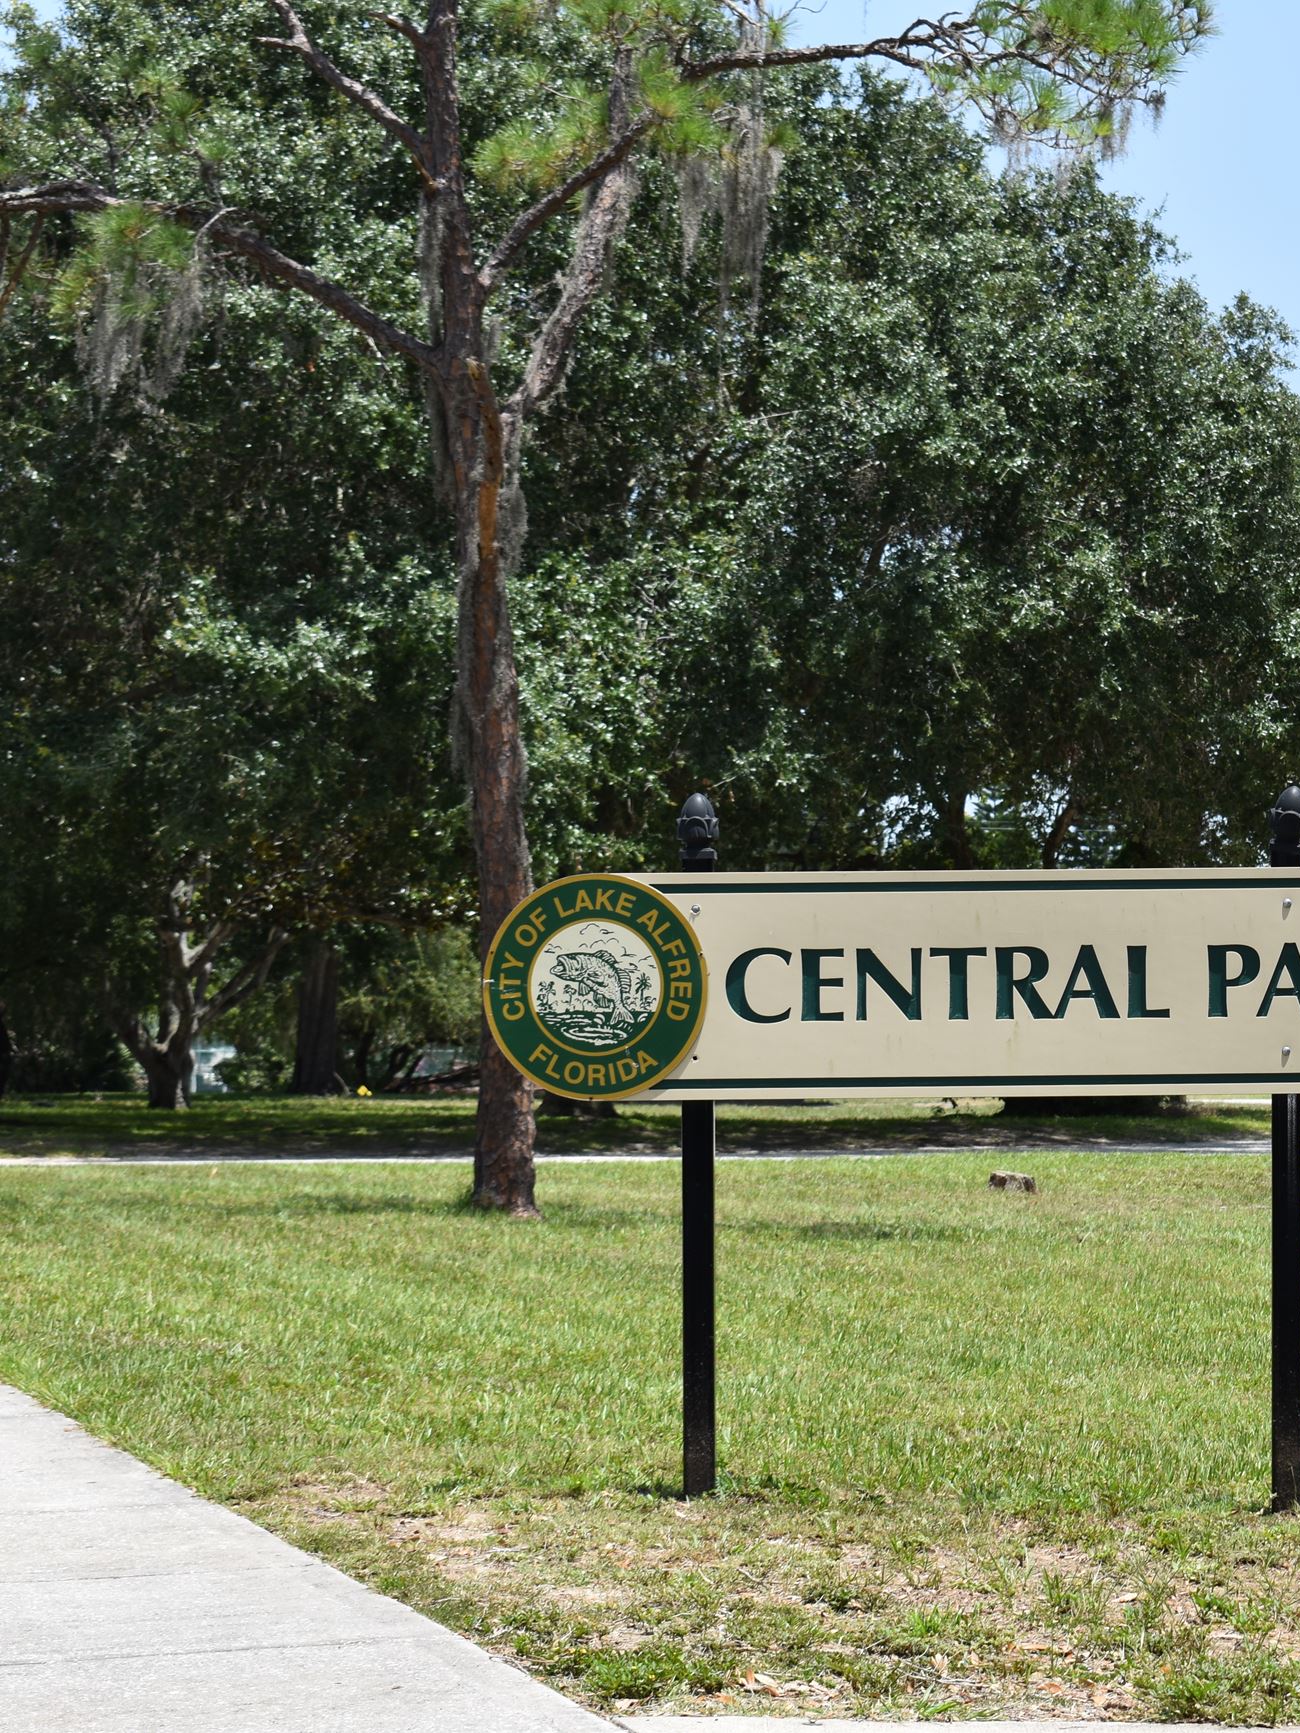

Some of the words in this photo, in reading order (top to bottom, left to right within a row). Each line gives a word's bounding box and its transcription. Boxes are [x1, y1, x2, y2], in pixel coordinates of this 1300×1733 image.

[500, 952, 525, 1021] CITY
[514, 907, 549, 947] OF
[553, 888, 637, 919] LAKE
[636, 908, 693, 1022] ALFRED
[725, 944, 1171, 1023] CENTRAL
[528, 1043, 659, 1086] FLORIDA
